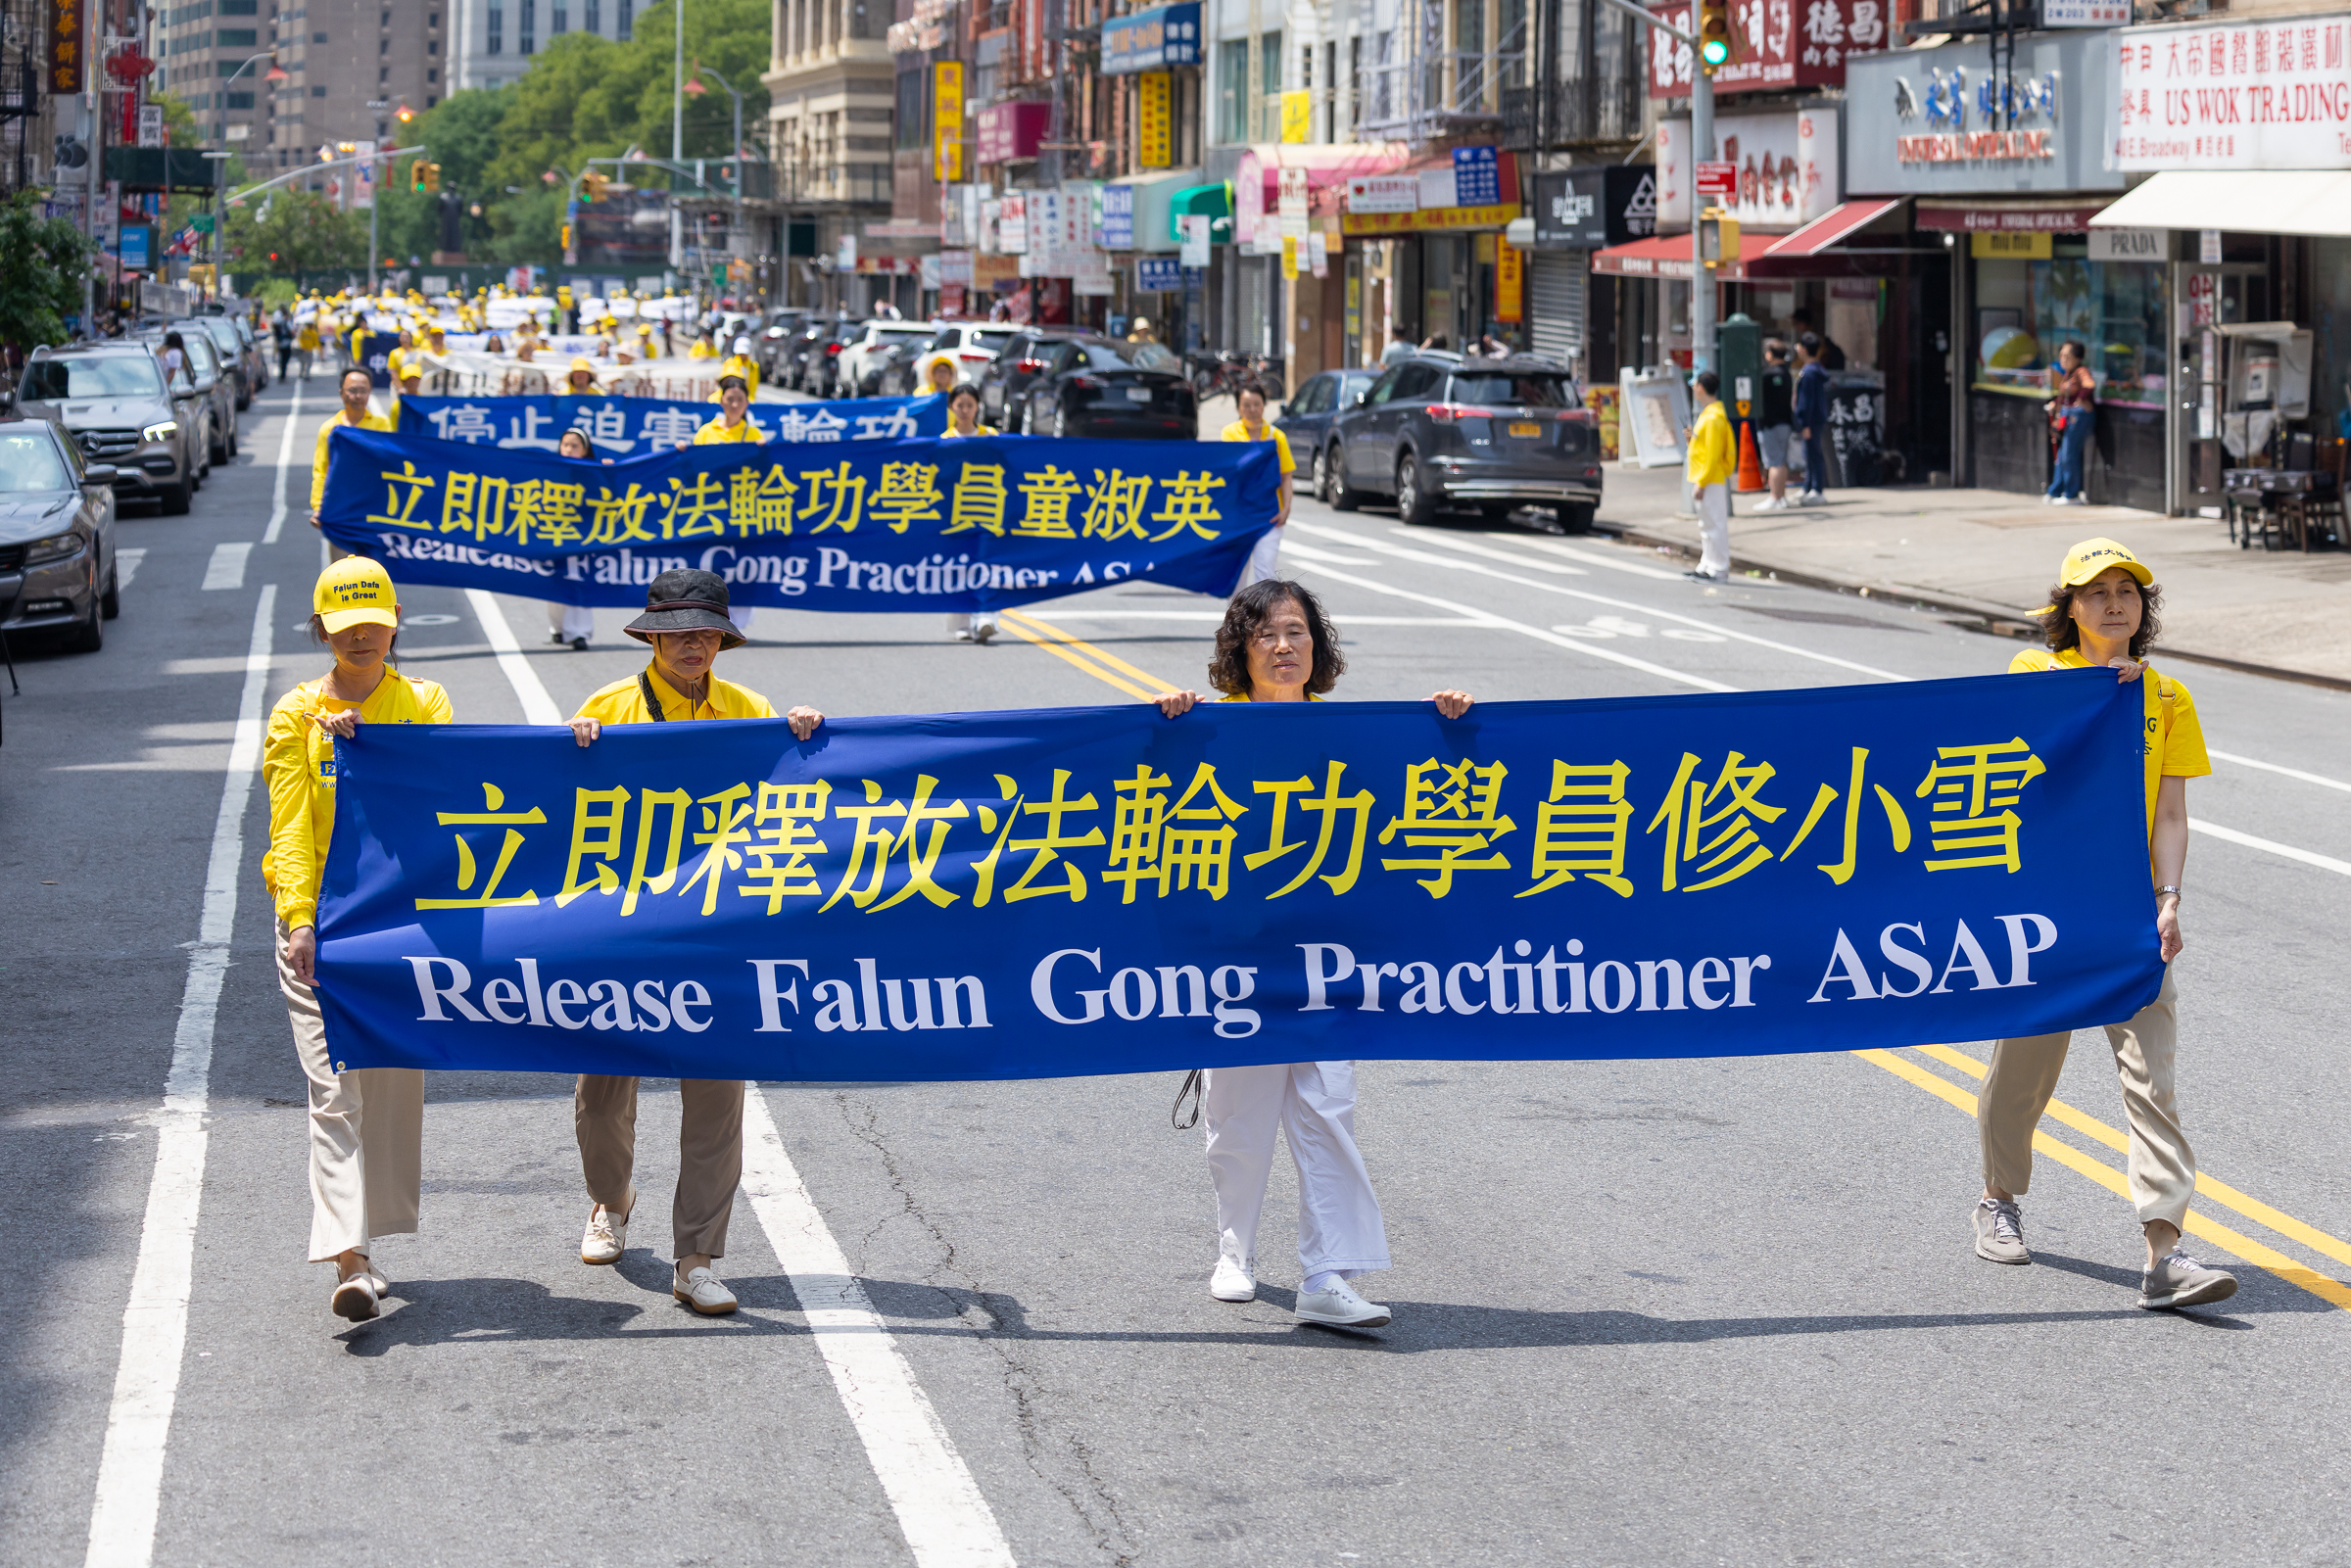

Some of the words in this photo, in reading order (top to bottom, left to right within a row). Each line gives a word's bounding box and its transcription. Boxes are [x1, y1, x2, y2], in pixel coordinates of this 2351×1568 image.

[1802, 0, 1883, 45] 德昌
[2166, 89, 2190, 125] US
[2196, 86, 2240, 124] WOK
[2247, 81, 2350, 123] TRADING
[366, 460, 1226, 546] 立即釋放法輪功學員童淑英
[333, 583, 358, 593] Falun
[699, 546, 809, 595] Gong
[815, 546, 1059, 594] Practitioner
[415, 736, 2046, 918] 立即釋放法輪功學員修小雪
[402, 956, 713, 1032] Release
[745, 958, 993, 1032] Falun
[1031, 947, 1262, 1039] Gong
[1295, 938, 1771, 1016] Practitioner
[1806, 913, 2057, 1005] ASAP
